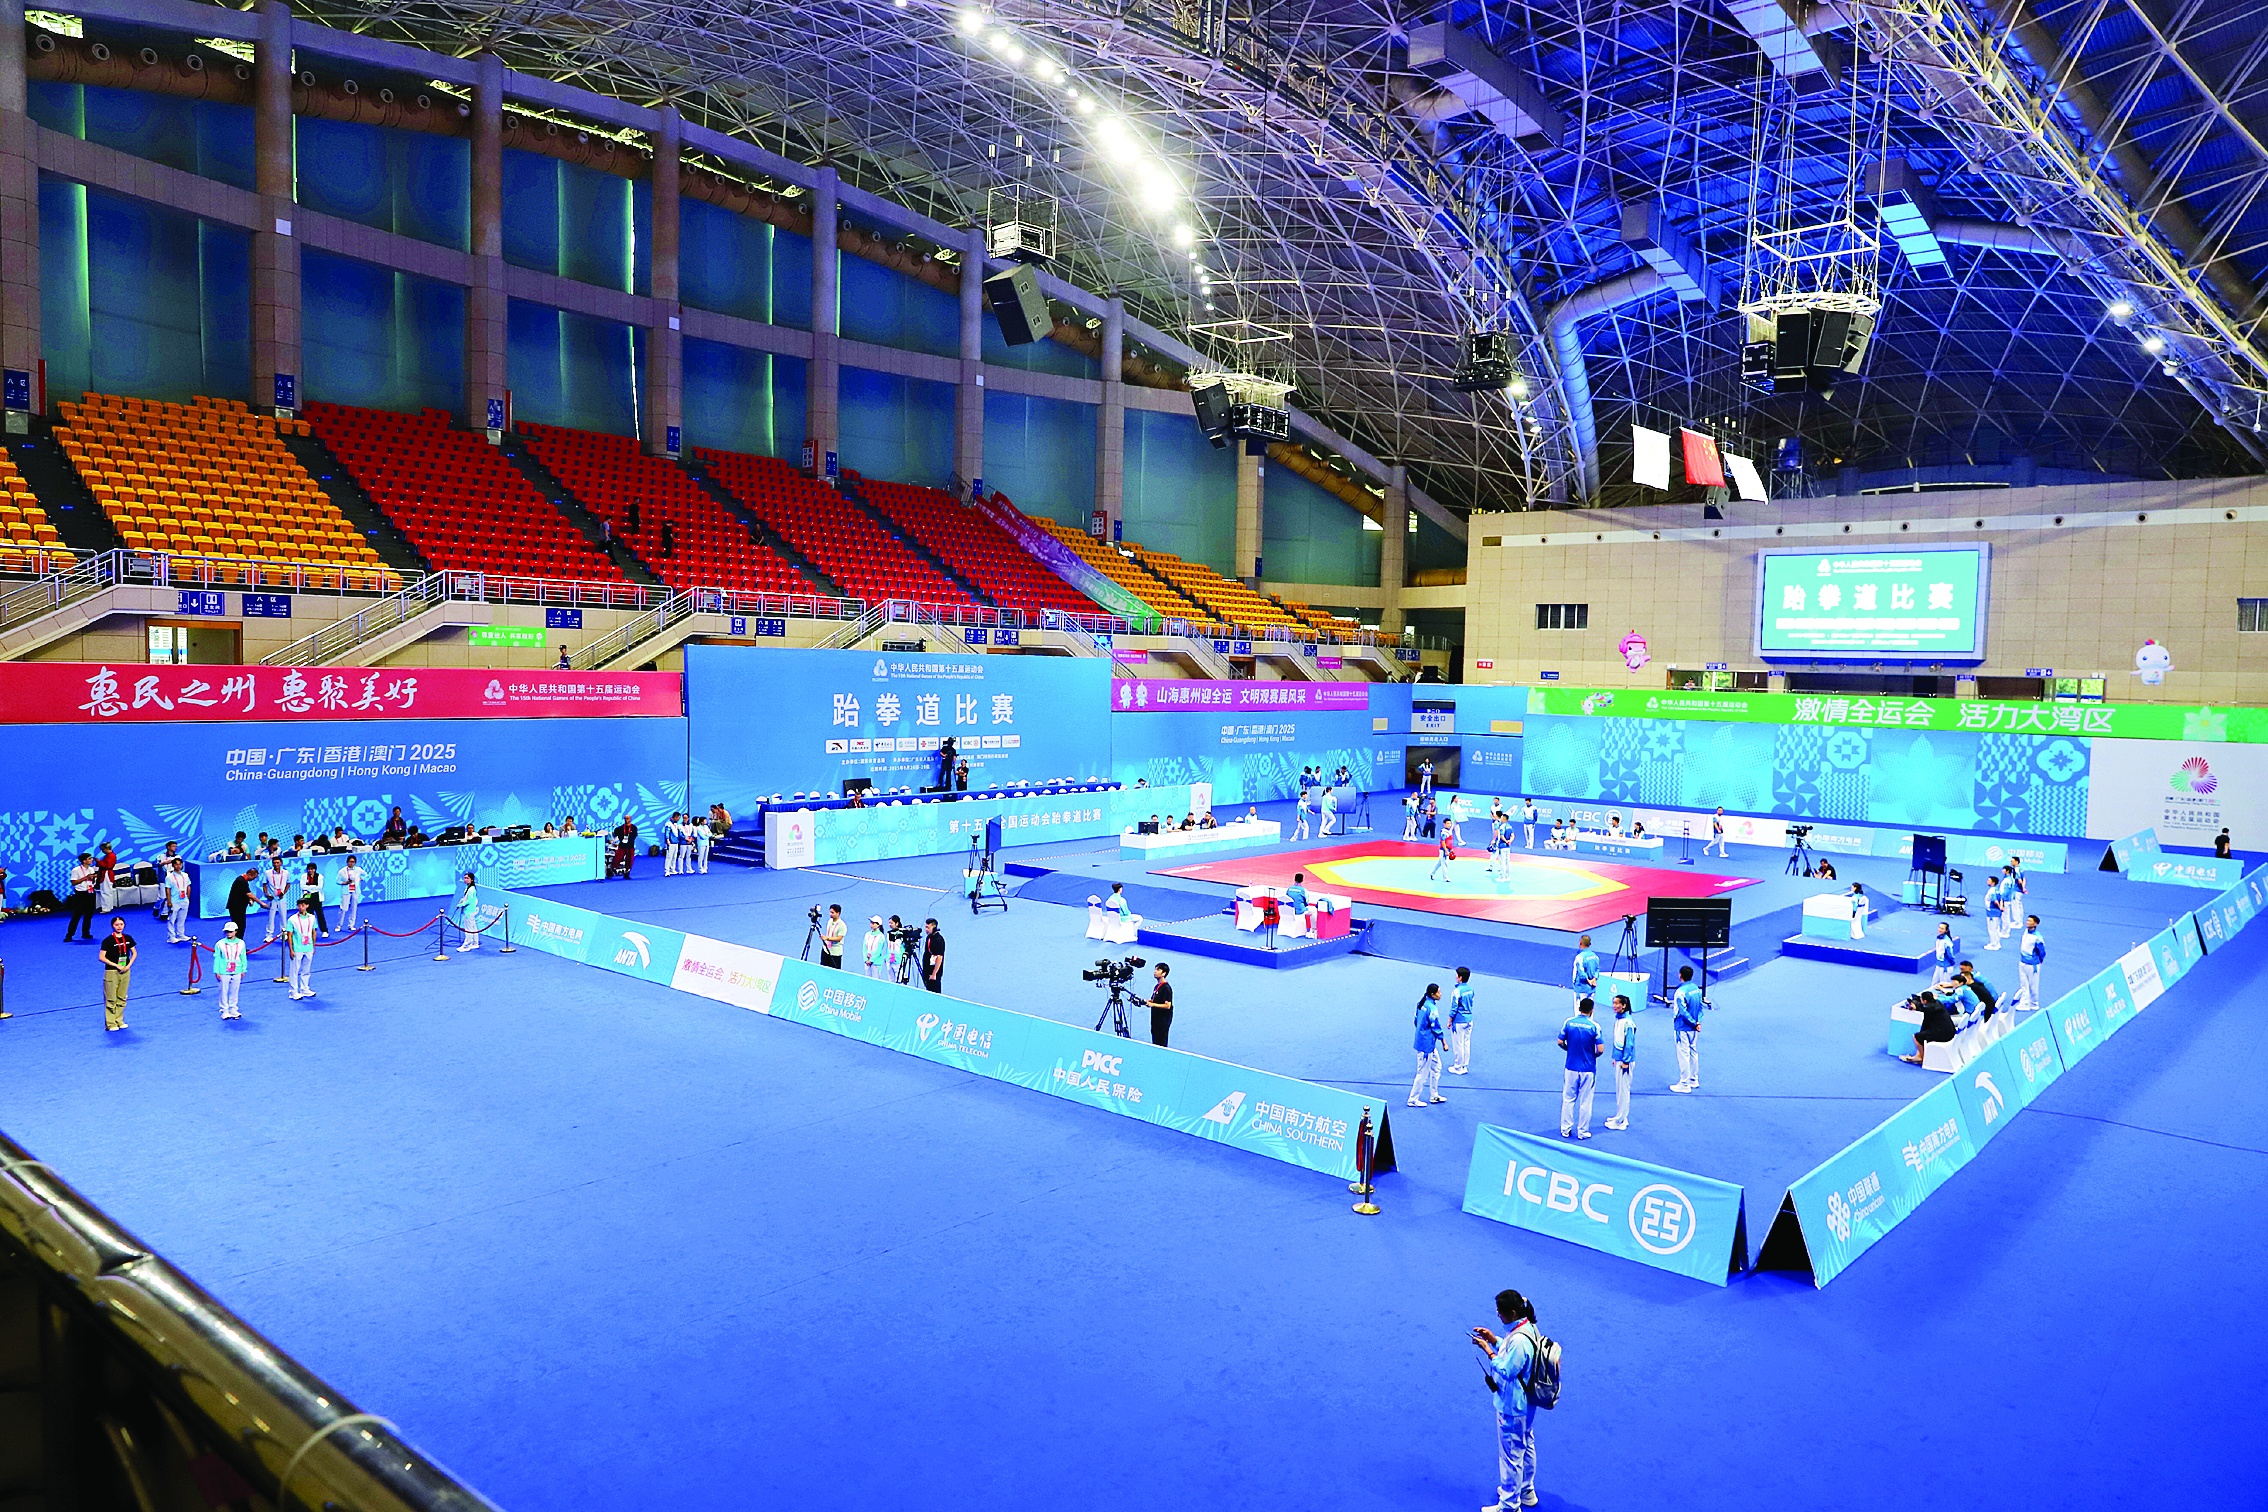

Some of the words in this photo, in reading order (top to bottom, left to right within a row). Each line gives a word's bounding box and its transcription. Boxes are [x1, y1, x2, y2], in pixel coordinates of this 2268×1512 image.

[890, 662, 984, 674] 中华人民共和国第十五届运动会
[78, 665, 255, 717] 惠民之州
[273, 669, 418, 713] 惠聚美好
[508, 683, 640, 695] 中华人民共和国第十五届运动会
[1156, 687, 1233, 704] 山海惠州迎全运
[1239, 688, 1306, 704] 文明观赛展风采
[832, 692, 1014, 728] 跆拳道比赛
[1792, 698, 1936, 726] 激情全运会
[1956, 703, 2116, 733] 活力大湾区
[1279, 724, 1295, 734] 2025
[410, 743, 457, 761] 2025
[347, 765, 379, 780] Hong
[381, 764, 411, 777] Kong
[419, 763, 457, 774] Macao
[1571, 809, 1600, 823] ICBC
[1814, 834, 1862, 844] 中国南方电网
[570, 853, 587, 861] 2025
[2007, 848, 2045, 858] 中国移动
[2174, 864, 2217, 878] 中国电信
[541, 920, 584, 941] 中国南方电网
[613, 948, 639, 967] ANTA
[727, 970, 773, 994] 活力大湾区
[822, 987, 867, 1011] 中国移动
[819, 1003, 839, 1016] China
[838, 1008, 862, 1023] Mobile
[941, 1018, 994, 1050] 中国电信
[937, 1039, 957, 1050] CHINA
[958, 1044, 990, 1059] TELECOM
[1081, 1048, 1123, 1077] PICC
[1052, 1067, 1144, 1103] 中国人民保险
[1254, 1100, 1348, 1139] 中国南方航空
[1982, 1095, 1999, 1126] ANTA
[1251, 1118, 1283, 1136] CHINA
[1285, 1127, 1344, 1152] SOUTHERN
[1919, 1117, 1959, 1157] 中国南方电网
[1503, 1159, 1614, 1224] ICBC
[1847, 1171, 1881, 1207] 中国联通
